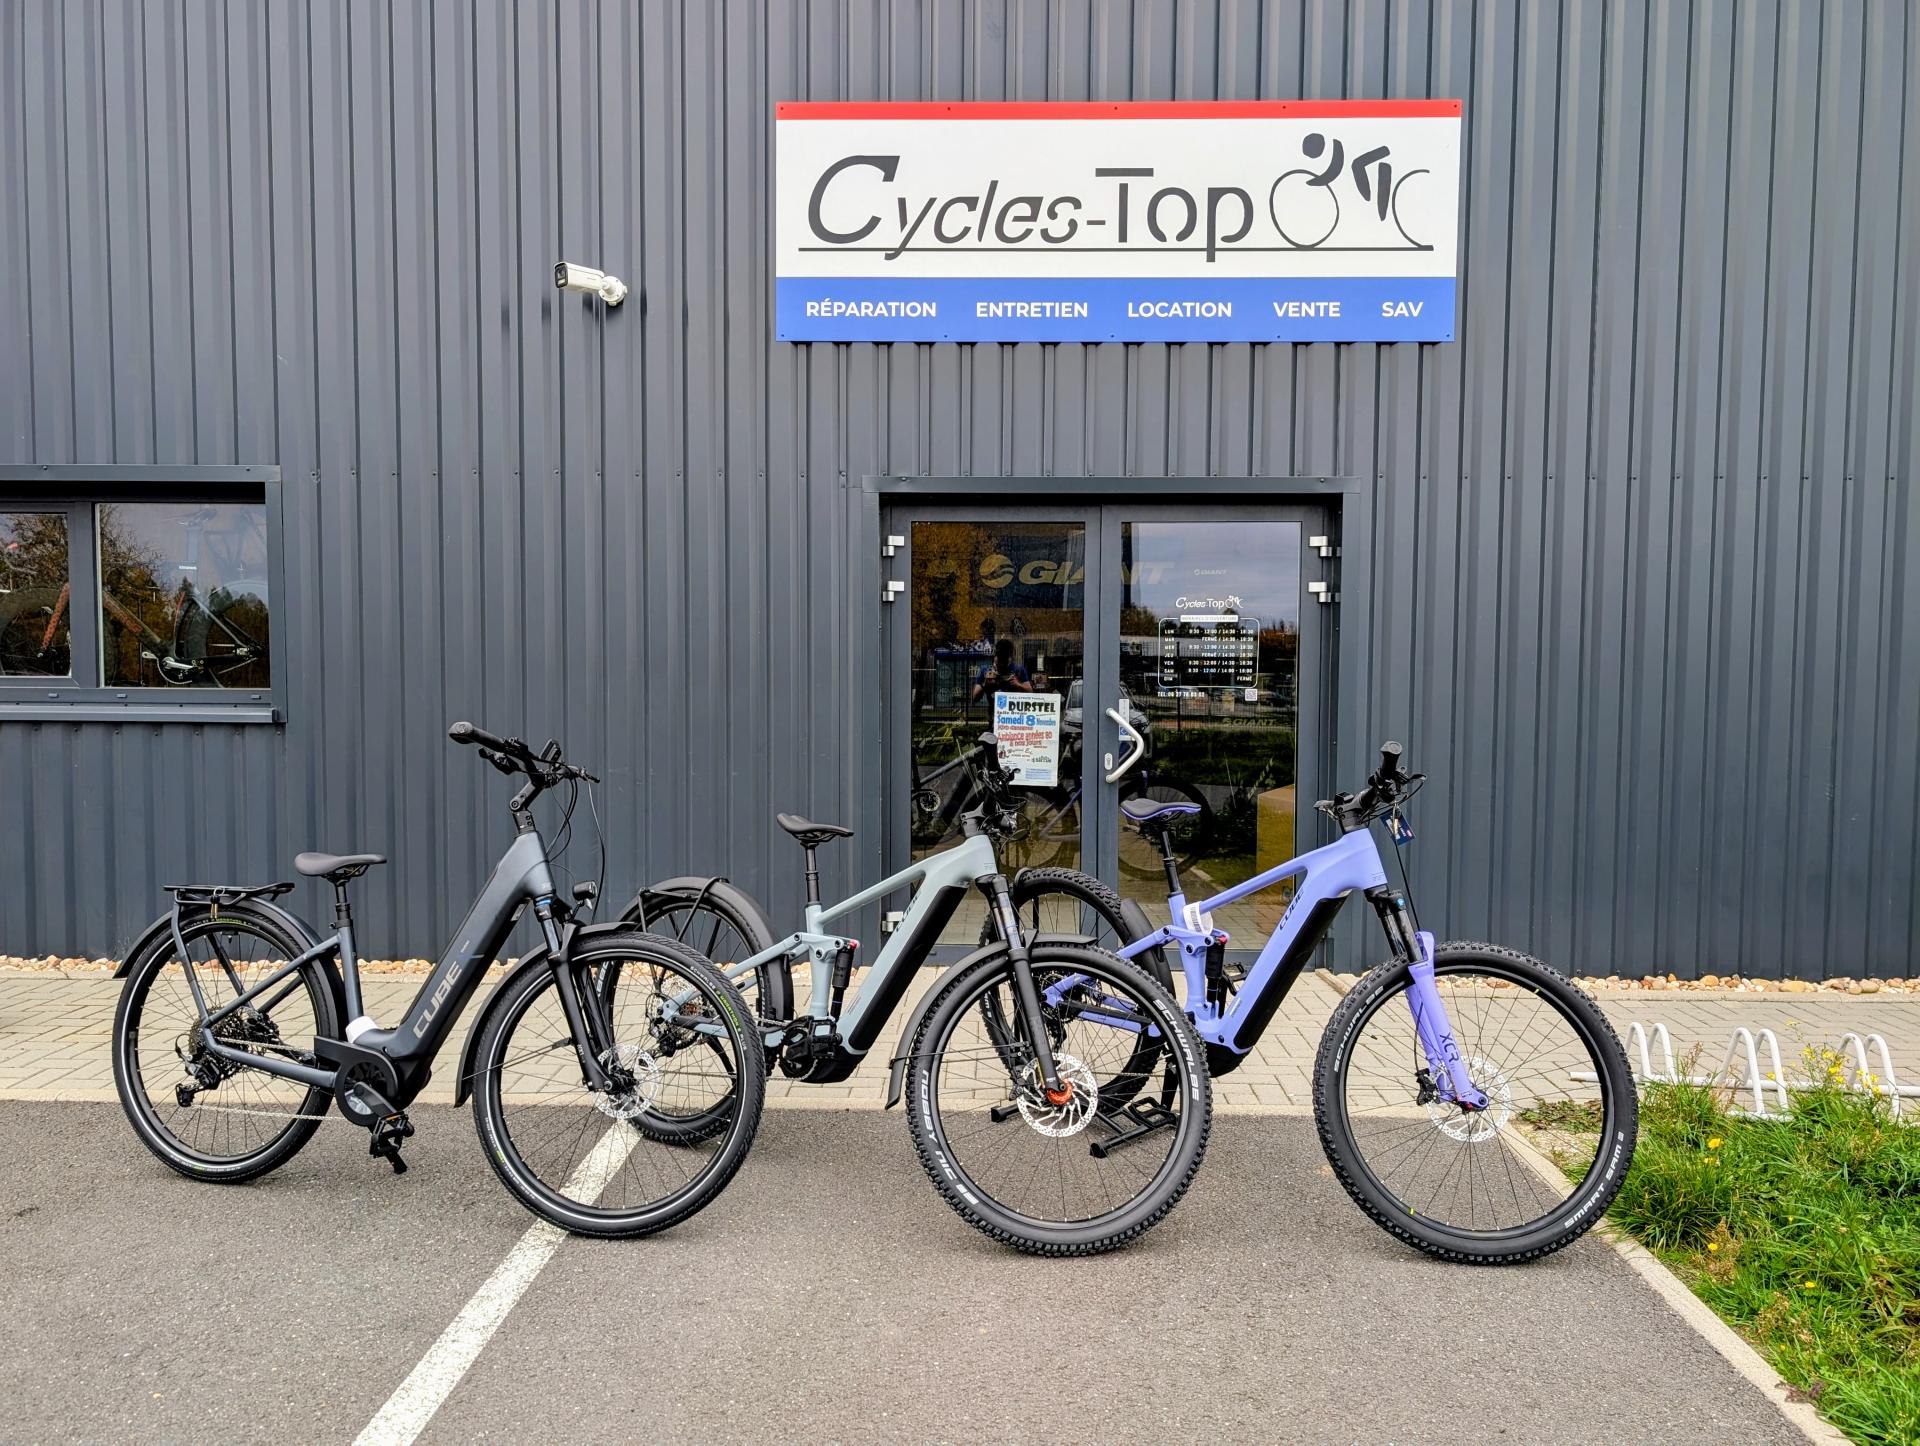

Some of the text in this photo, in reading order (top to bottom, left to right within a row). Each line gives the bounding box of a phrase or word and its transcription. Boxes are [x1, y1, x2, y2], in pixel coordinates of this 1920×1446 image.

[806, 154, 1254, 263] Cycles-Top
[805, 297, 1424, 318] RÉPARATION ENTRETIEN LOCATION VENTE SAV
[997, 715, 1024, 724] Samedi
[1026, 715, 1035, 726] 8
[1009, 701, 1056, 712] DURSTEL
[413, 961, 462, 1038] CUBE
[690, 966, 716, 990] SCHWALBE
[720, 995, 740, 1027] MARATHON
[1333, 985, 1384, 1072] SCHWALBE
[1152, 999, 1199, 1102] SCHWALBE
[1440, 1032, 1459, 1062] XCR
[921, 1069, 958, 1180] NOBBY NIC
[1564, 1144, 1622, 1228] SMART SAM
